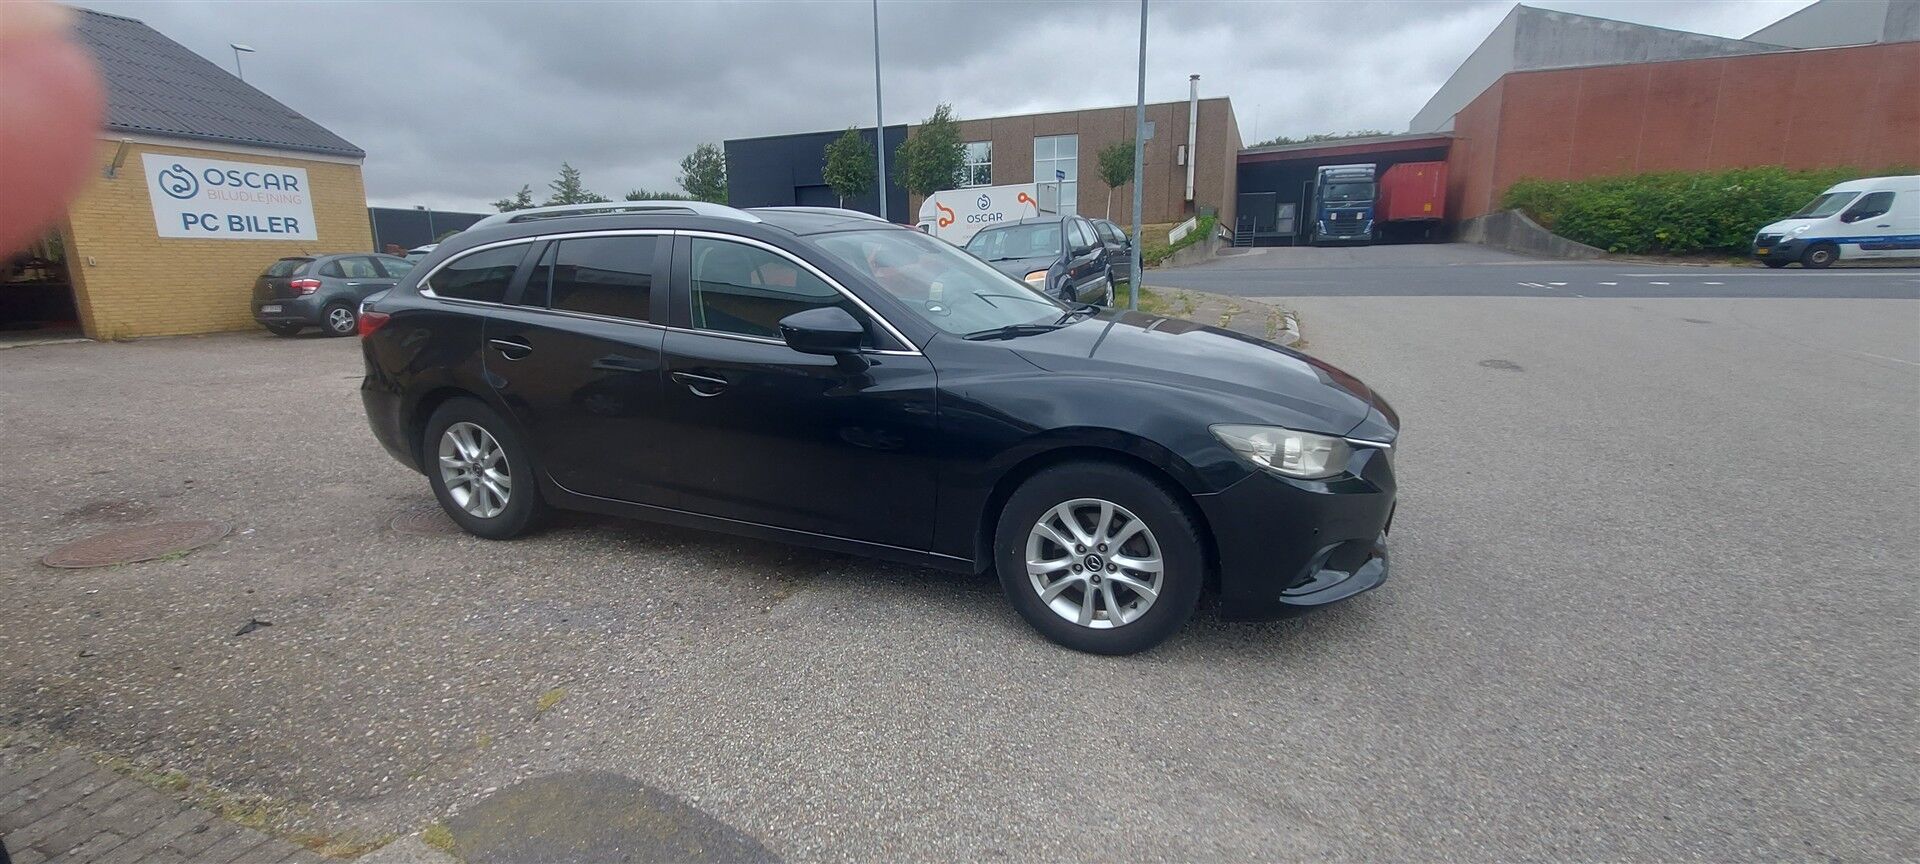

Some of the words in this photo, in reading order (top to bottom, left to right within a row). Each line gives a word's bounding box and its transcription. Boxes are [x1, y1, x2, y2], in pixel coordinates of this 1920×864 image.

[203, 168, 300, 192] OSCAR
[207, 189, 302, 205] BILUDLEJNING
[181, 212, 220, 232] PC
[227, 214, 300, 234] BILER
[966, 212, 1003, 224] OSCAR
